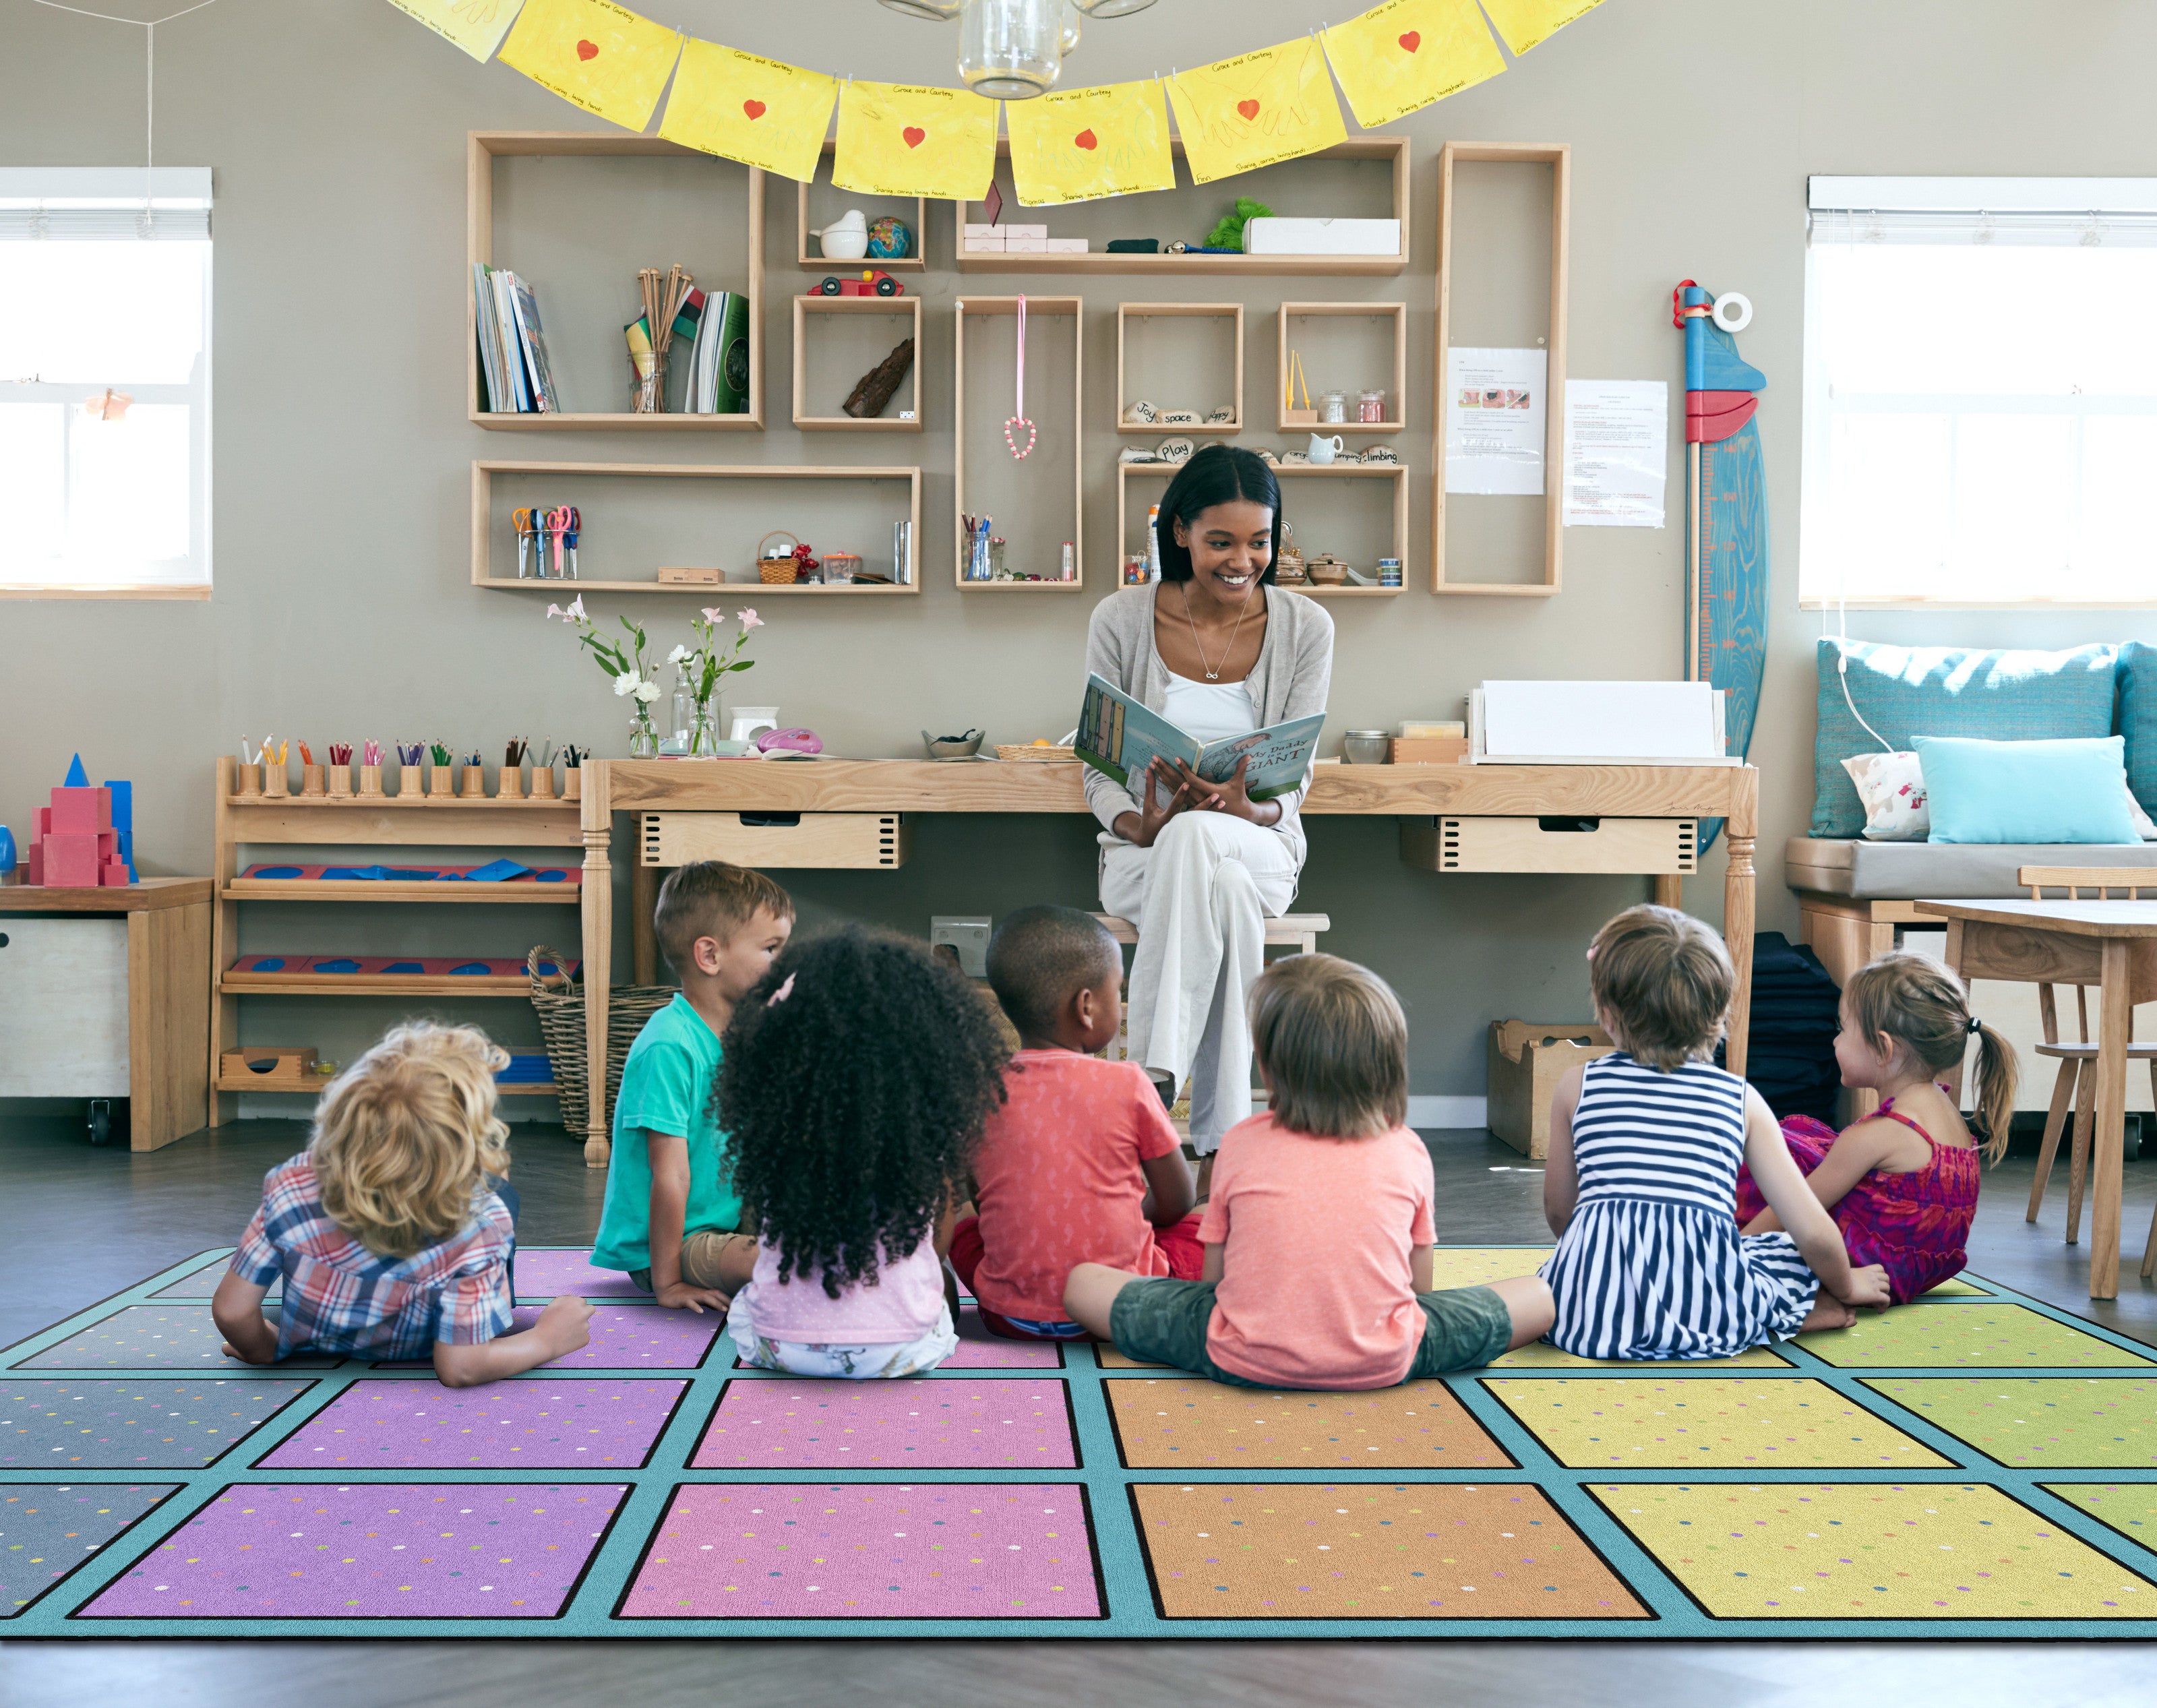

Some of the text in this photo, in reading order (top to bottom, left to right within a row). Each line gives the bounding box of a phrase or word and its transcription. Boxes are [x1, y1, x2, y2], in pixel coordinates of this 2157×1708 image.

[613, 7, 634, 24] Courtesy
[1366, 2, 1397, 20] Grace and
[1516, 38, 1539, 55] Caitlin
[734, 51, 752, 61] Grace
[770, 61, 793, 75] Courtesy
[1212, 63, 1230, 72] Grace
[1247, 51, 1272, 62] Courtesy
[572, 93, 584, 106] loving
[930, 88, 954, 100] Courtesy
[1045, 94, 1064, 102] Grace
[1086, 90, 1111, 98] Courtesy
[741, 156, 756, 166] loving
[1019, 196, 1045, 206] Thomas
[1137, 402, 1156, 423] Joy
[1165, 415, 1192, 423] space
[1162, 444, 1189, 460] Play
[1724, 443, 1737, 453] 140
[1335, 453, 1362, 463] umping
[1362, 450, 1397, 464] climbing
[1724, 491, 1737, 502] 130
[1724, 541, 1736, 551] 120
[1724, 590, 1736, 600] 110
[1723, 638, 1736, 648] 100
[1271, 739, 1308, 754] Daddy
[1245, 748, 1305, 772] GIANT
